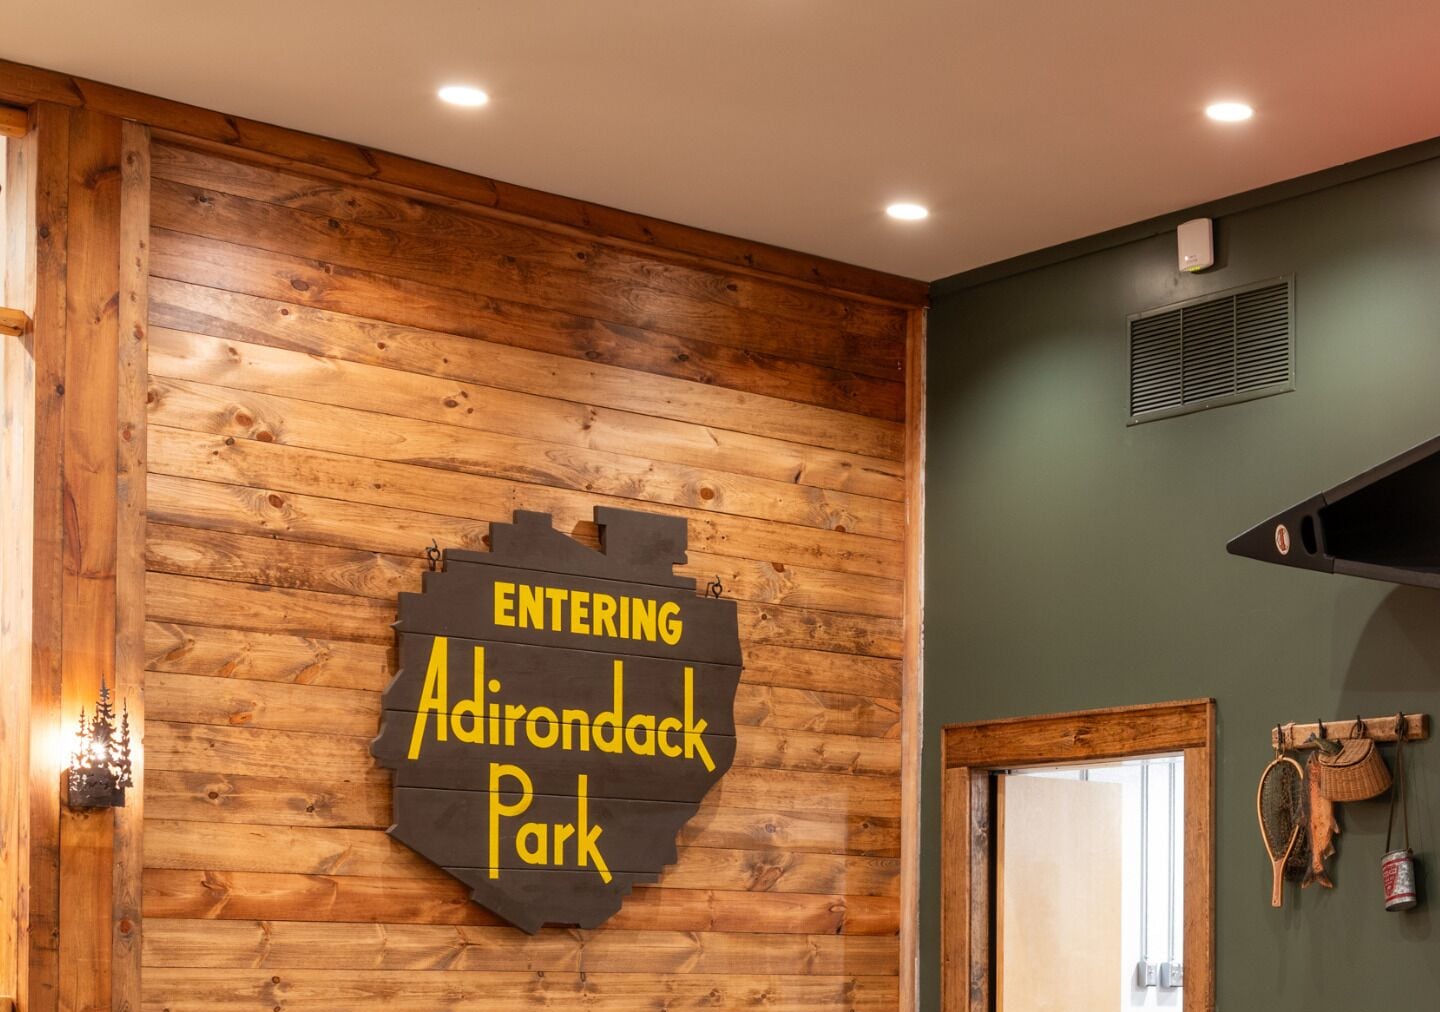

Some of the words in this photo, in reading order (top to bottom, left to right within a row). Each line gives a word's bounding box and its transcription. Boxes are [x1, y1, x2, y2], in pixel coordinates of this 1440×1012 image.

[494, 581, 683, 646] ENTERING
[408, 636, 716, 772] Adirondack
[489, 763, 613, 884] Park
